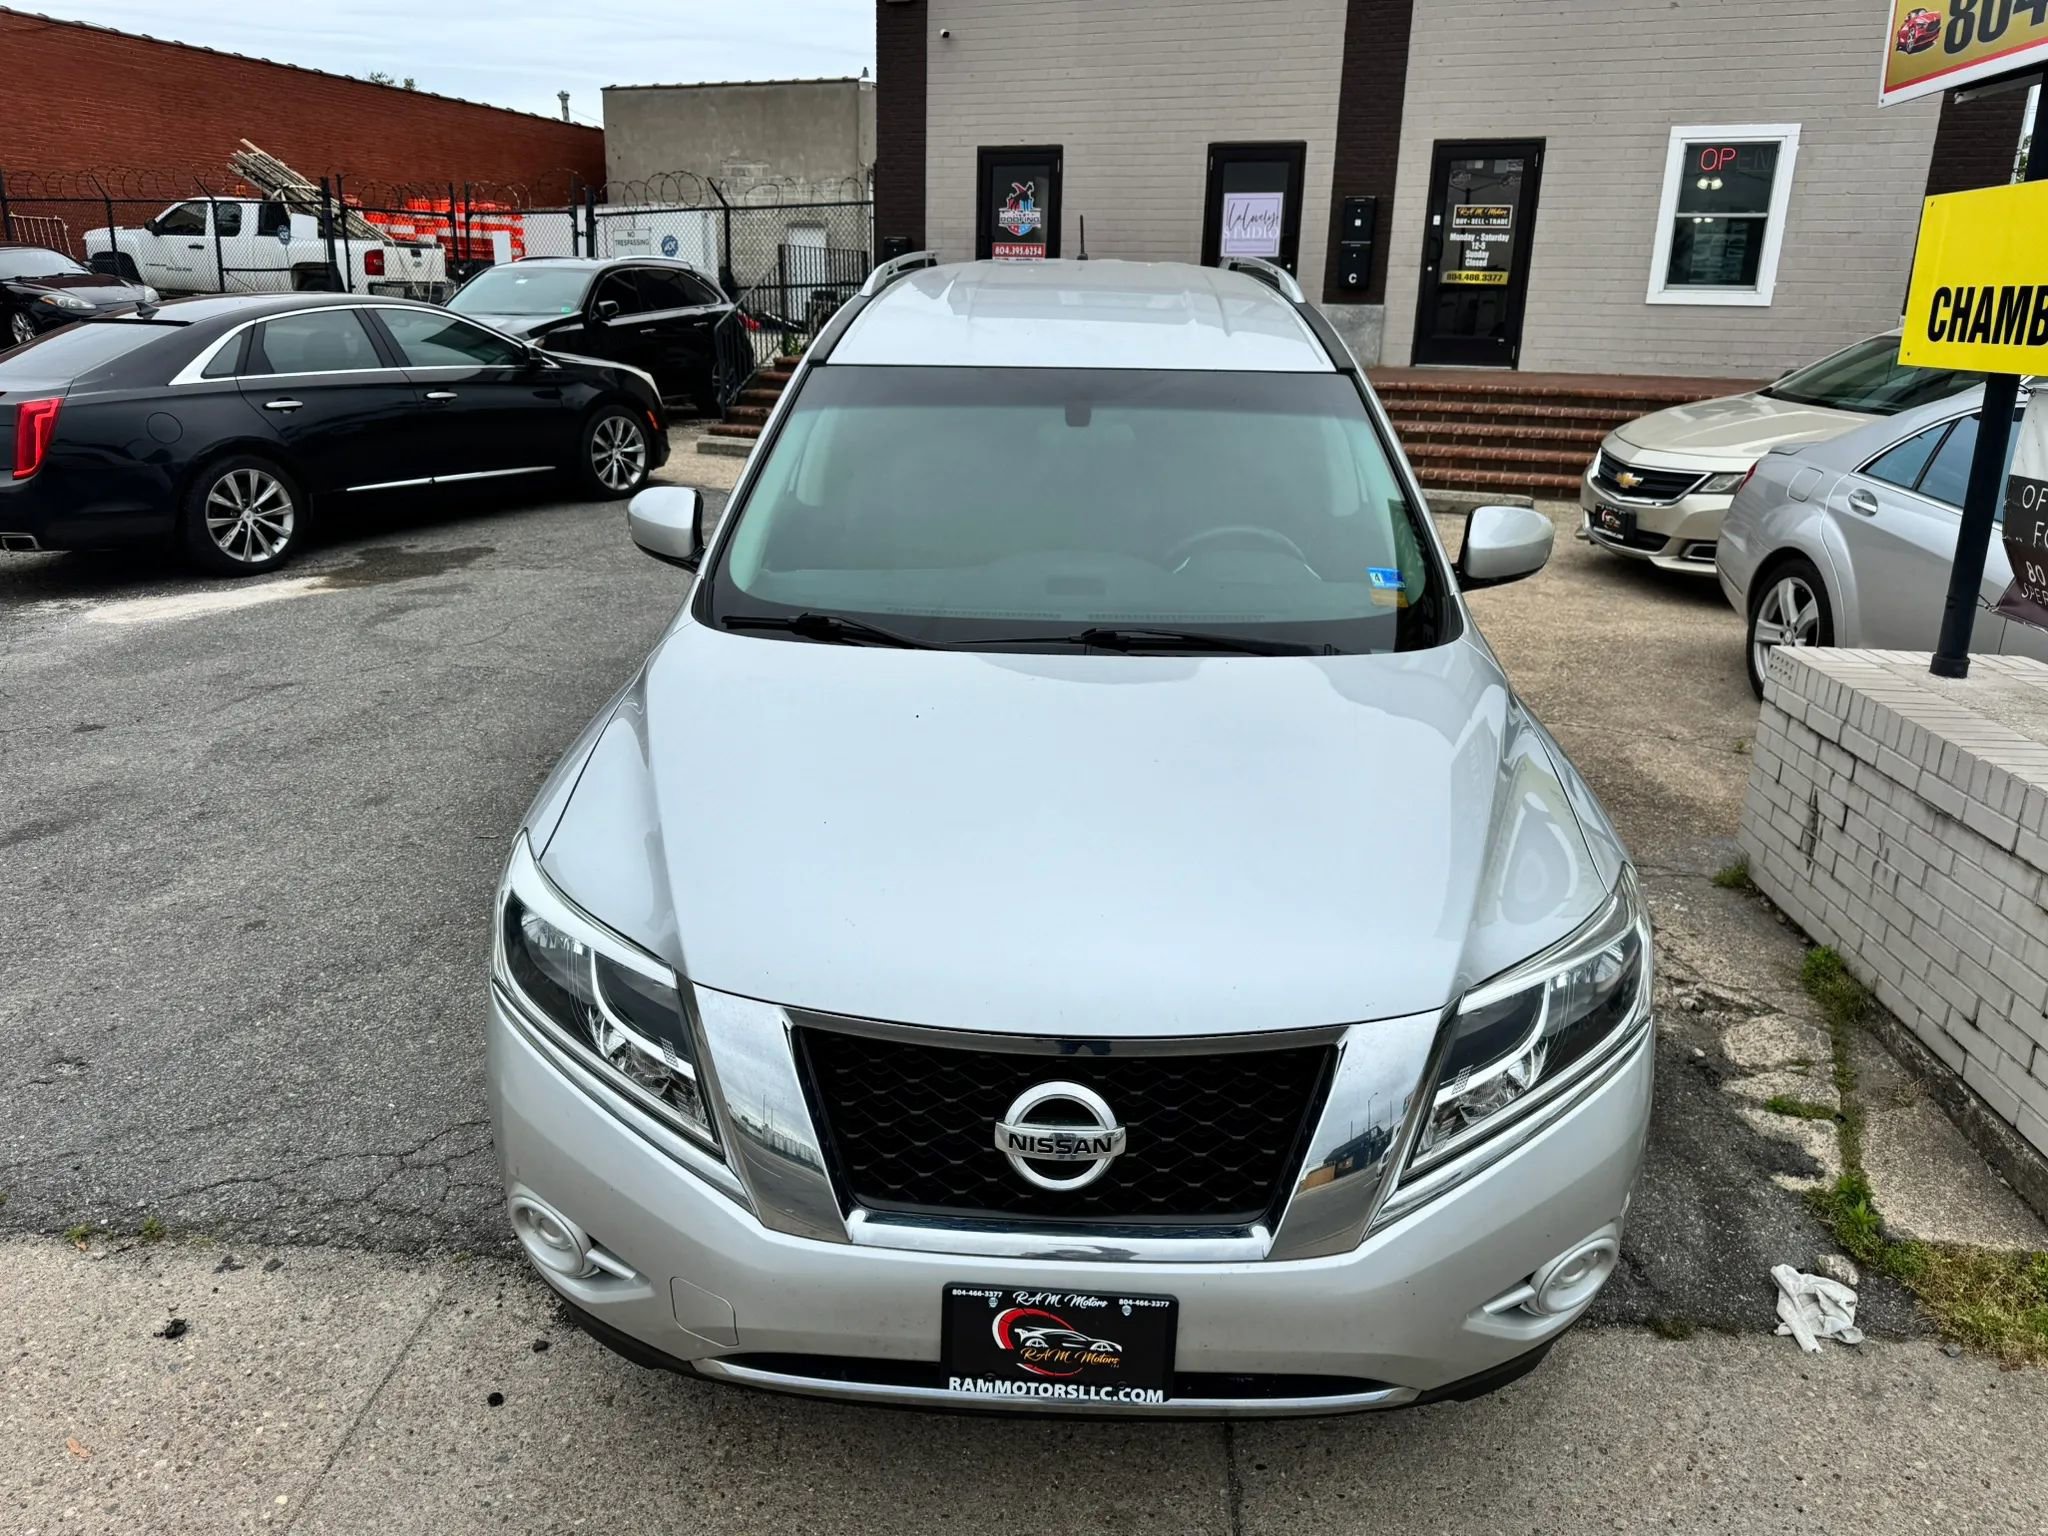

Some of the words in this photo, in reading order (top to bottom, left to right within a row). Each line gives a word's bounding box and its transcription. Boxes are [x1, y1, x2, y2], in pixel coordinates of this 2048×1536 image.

[1449, 233, 1476, 241] Monday
[1480, 233, 1509, 242] Saturday
[1348, 272, 1357, 283] C
[1008, 1132, 1112, 1155] NISSAN
[952, 1288, 1003, 1298] 804-466-3377
[1012, 1290, 1062, 1308] RAM
[1064, 1293, 1108, 1309] Motors
[1118, 1298, 1170, 1308] 804-466-3377
[1020, 1347, 1073, 1364] RAM
[1074, 1351, 1120, 1366] Motors
[949, 1377, 1164, 1404] RAMMOTORSLLC.COM
